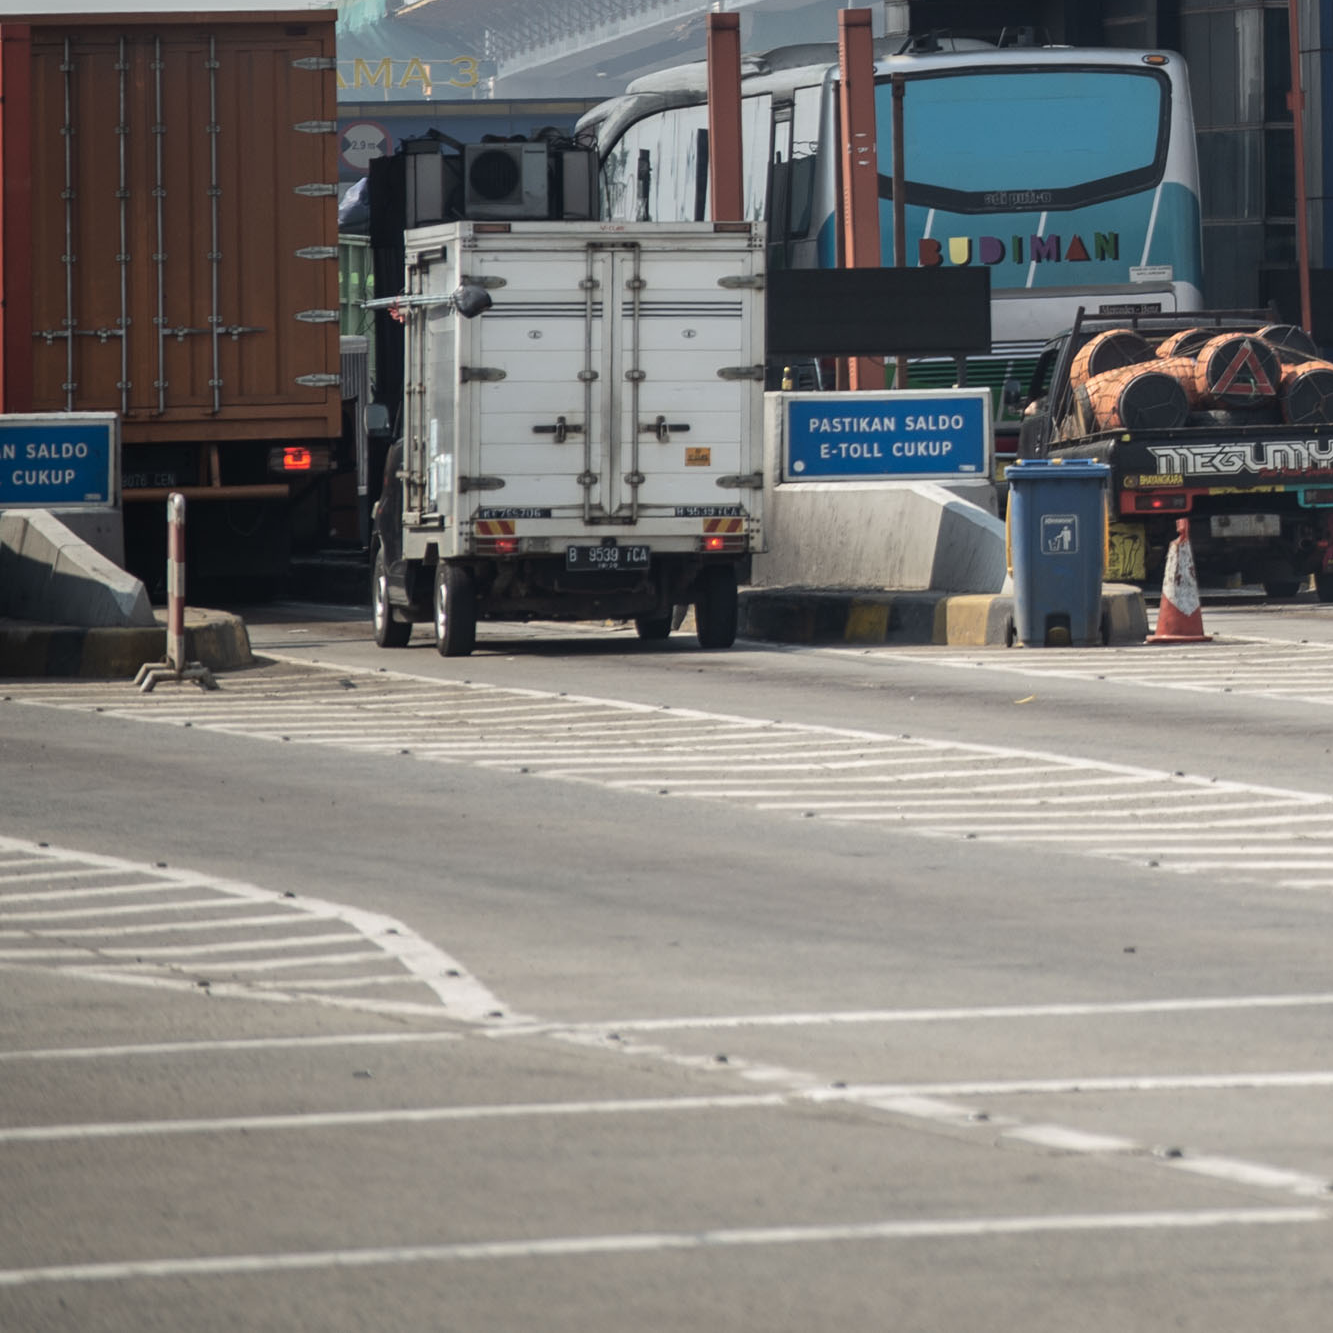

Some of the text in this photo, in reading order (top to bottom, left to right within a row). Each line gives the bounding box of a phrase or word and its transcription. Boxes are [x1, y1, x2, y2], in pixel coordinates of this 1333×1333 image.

[450, 54, 480, 88] 3
[918, 231, 1120, 266] BUDIMAN
[808, 415, 964, 434] PASTIKAN SALDO
[26, 443, 88, 459] SALDO
[819, 441, 954, 459] E-TOLL CUKUP
[12, 469, 76, 485] CUKUP
[568, 547, 578, 563] B
[588, 546, 620, 563] 9539
